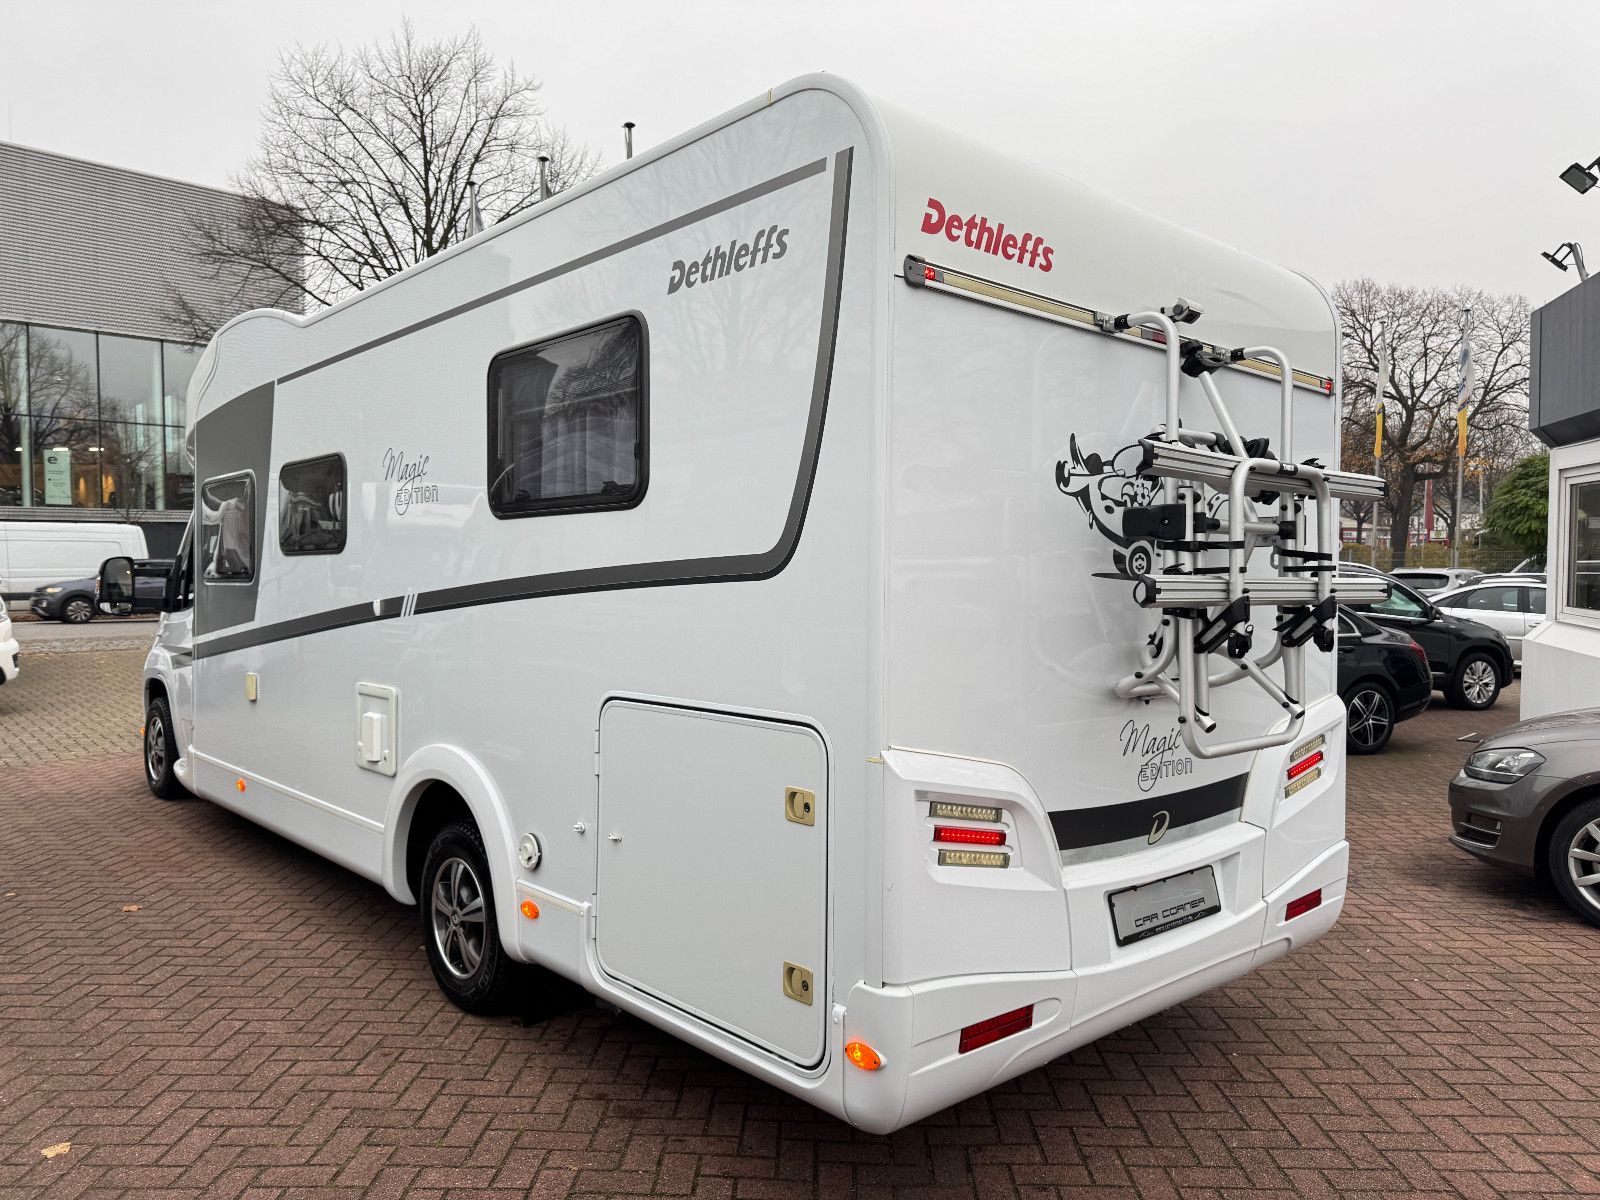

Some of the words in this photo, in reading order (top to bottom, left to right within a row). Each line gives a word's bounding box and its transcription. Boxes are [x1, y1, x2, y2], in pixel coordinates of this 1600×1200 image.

[667, 224, 790, 295] Dethleffs
[920, 197, 1055, 272] Dethleffs
[382, 447, 430, 516] Magic
[1119, 719, 1181, 792] Magic
[1134, 912, 1160, 928] CAR
